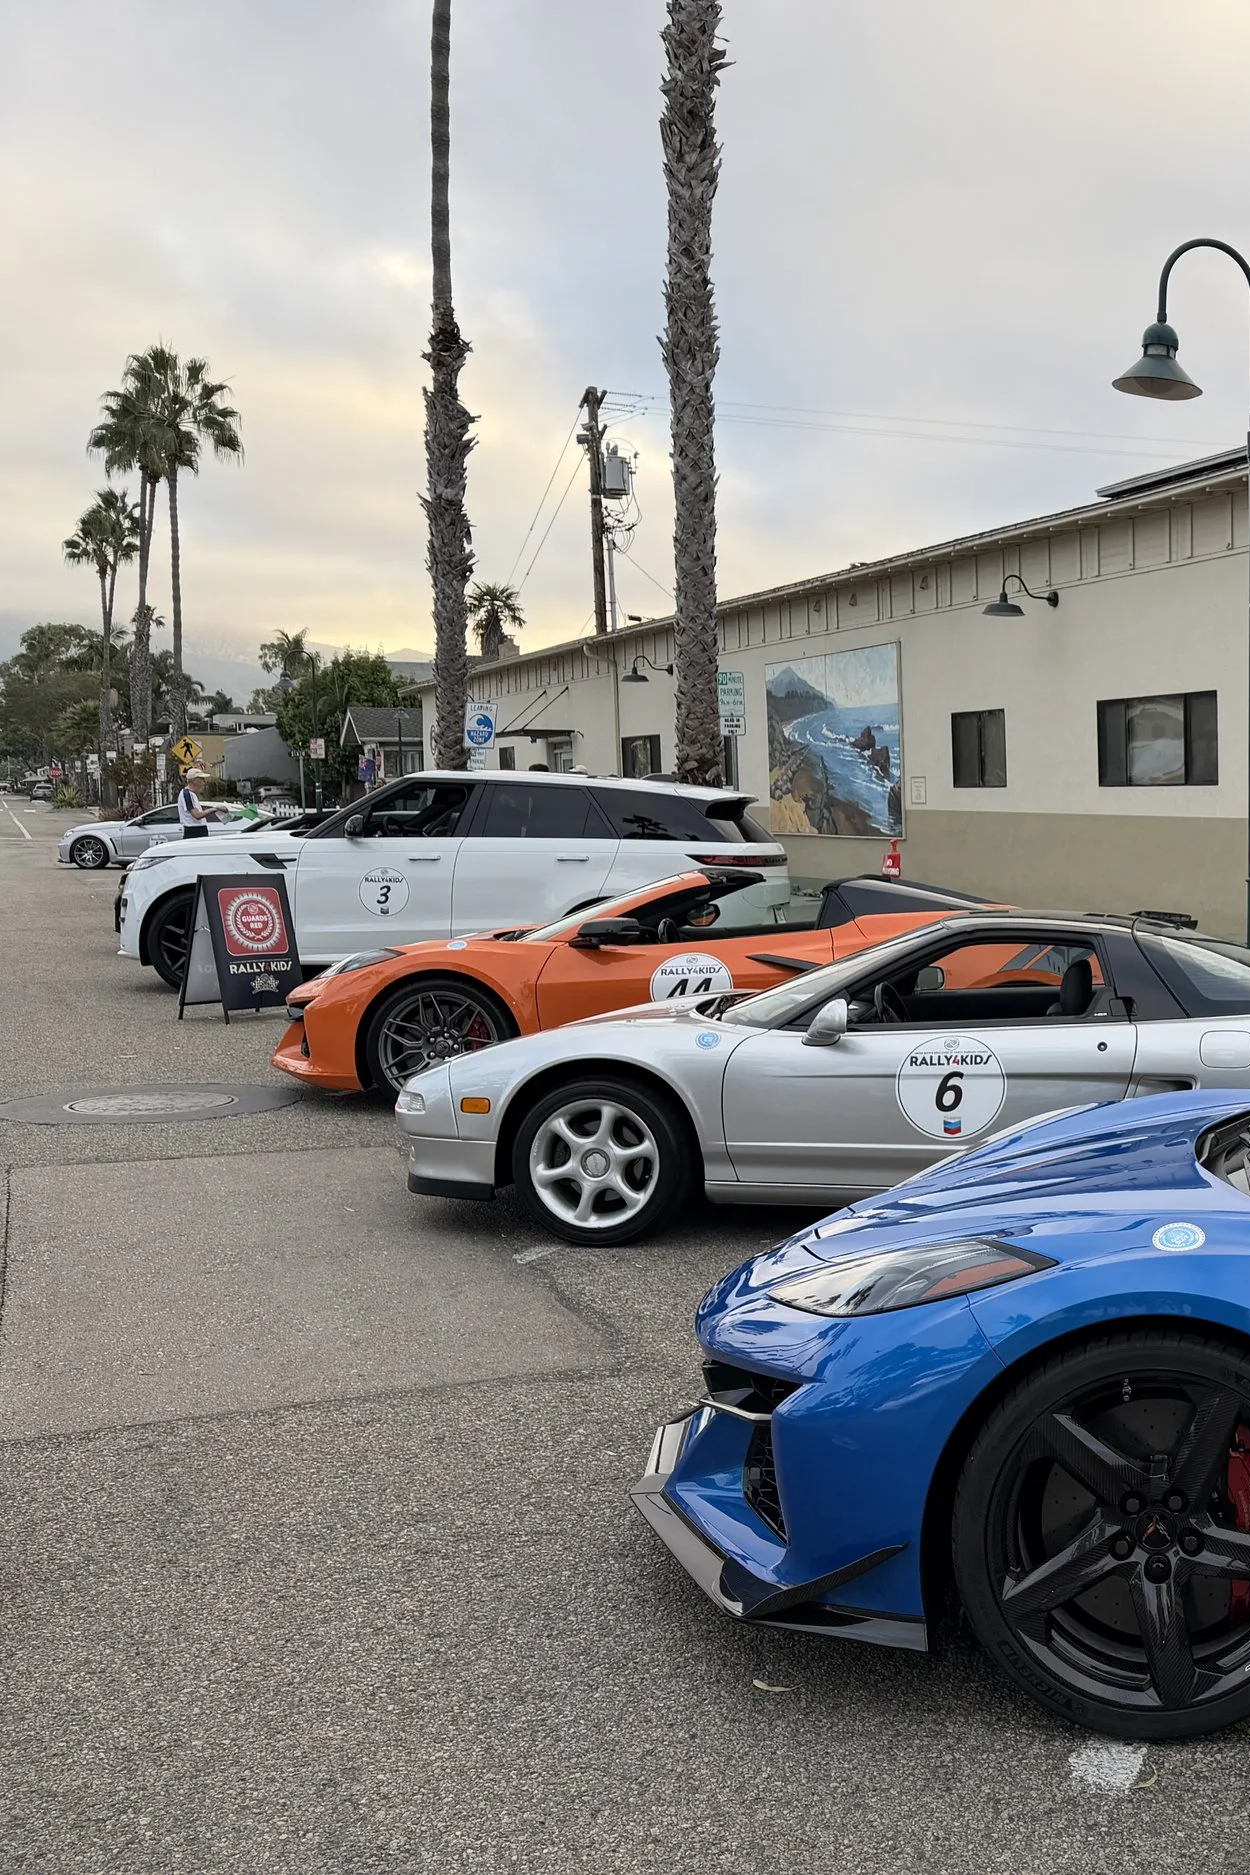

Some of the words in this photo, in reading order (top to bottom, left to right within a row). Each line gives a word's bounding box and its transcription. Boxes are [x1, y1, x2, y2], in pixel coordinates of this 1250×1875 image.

[376, 885, 391, 904] 3
[229, 961, 292, 974] RALLY4KIDS
[660, 966, 722, 976] RALLY4KIDS
[909, 1054, 992, 1066] RALLY4KIDS
[935, 1070, 964, 1112] 6
